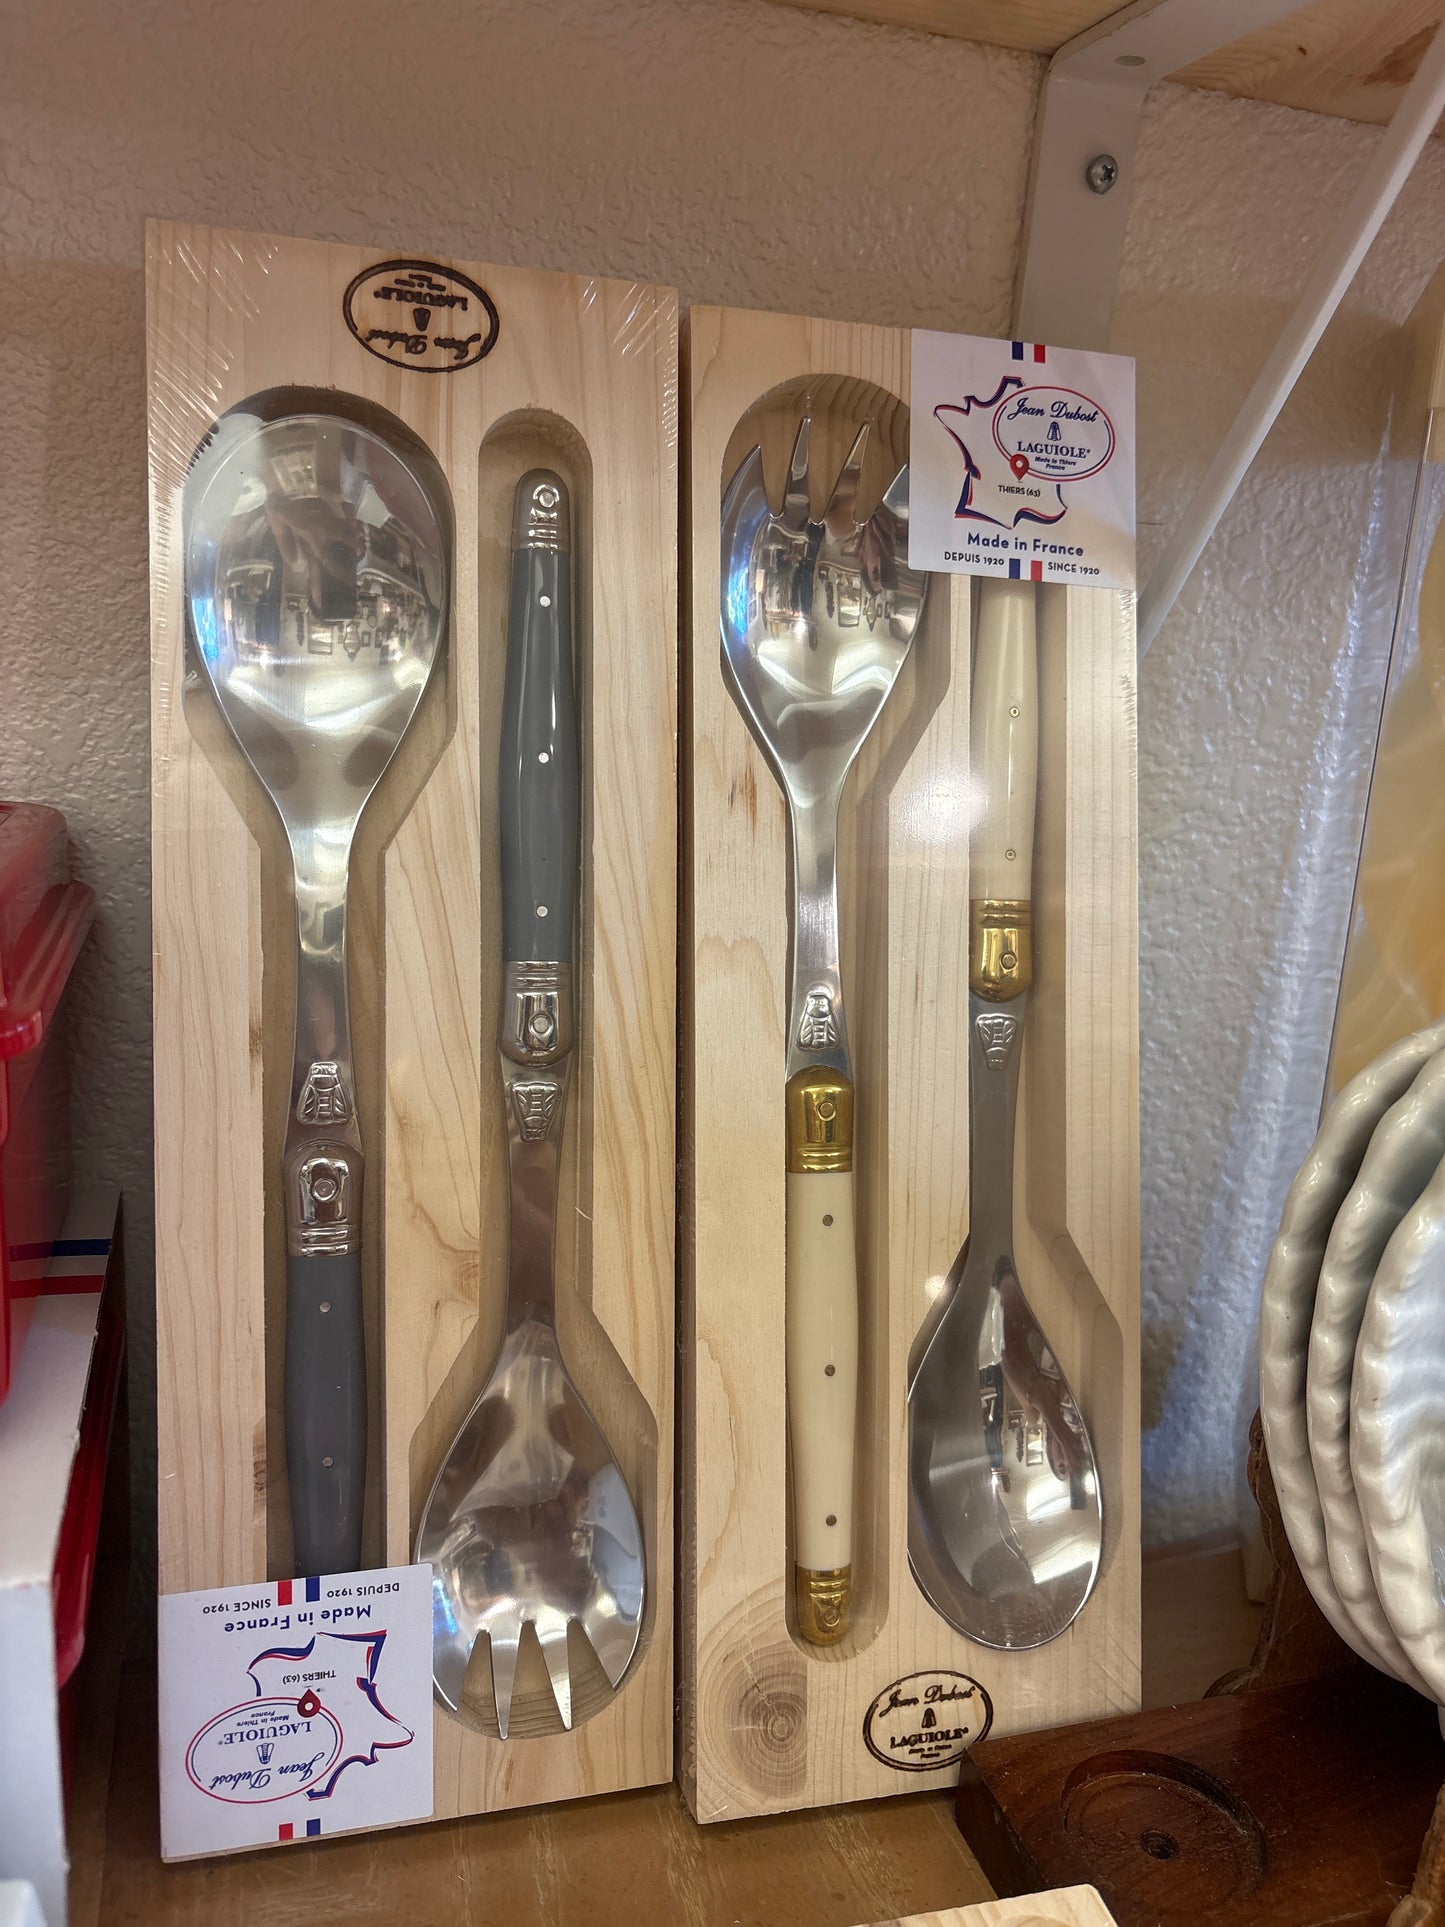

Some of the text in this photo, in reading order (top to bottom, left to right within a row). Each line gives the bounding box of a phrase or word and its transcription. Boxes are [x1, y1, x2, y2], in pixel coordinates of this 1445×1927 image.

[1007, 397, 1099, 422] Jean Dubost
[1046, 463, 1065, 471] France
[998, 485, 1040, 498] THIERS (63)
[967, 532, 1083, 556] Made in France
[944, 552, 1004, 566] DEPUIS 1920
[1048, 562, 1099, 575] SINCE 1920
[327, 1582, 399, 1598] DEPUIS 1920
[203, 1598, 271, 1614] SINCE 1920
[224, 1605, 371, 1633] Made in France
[283, 1670, 336, 1685] THIERS (63)
[237, 1719, 259, 1727] Thiers
[270, 1714, 289, 1722] Made
[210, 1752, 325, 1790] Jean Dubost
